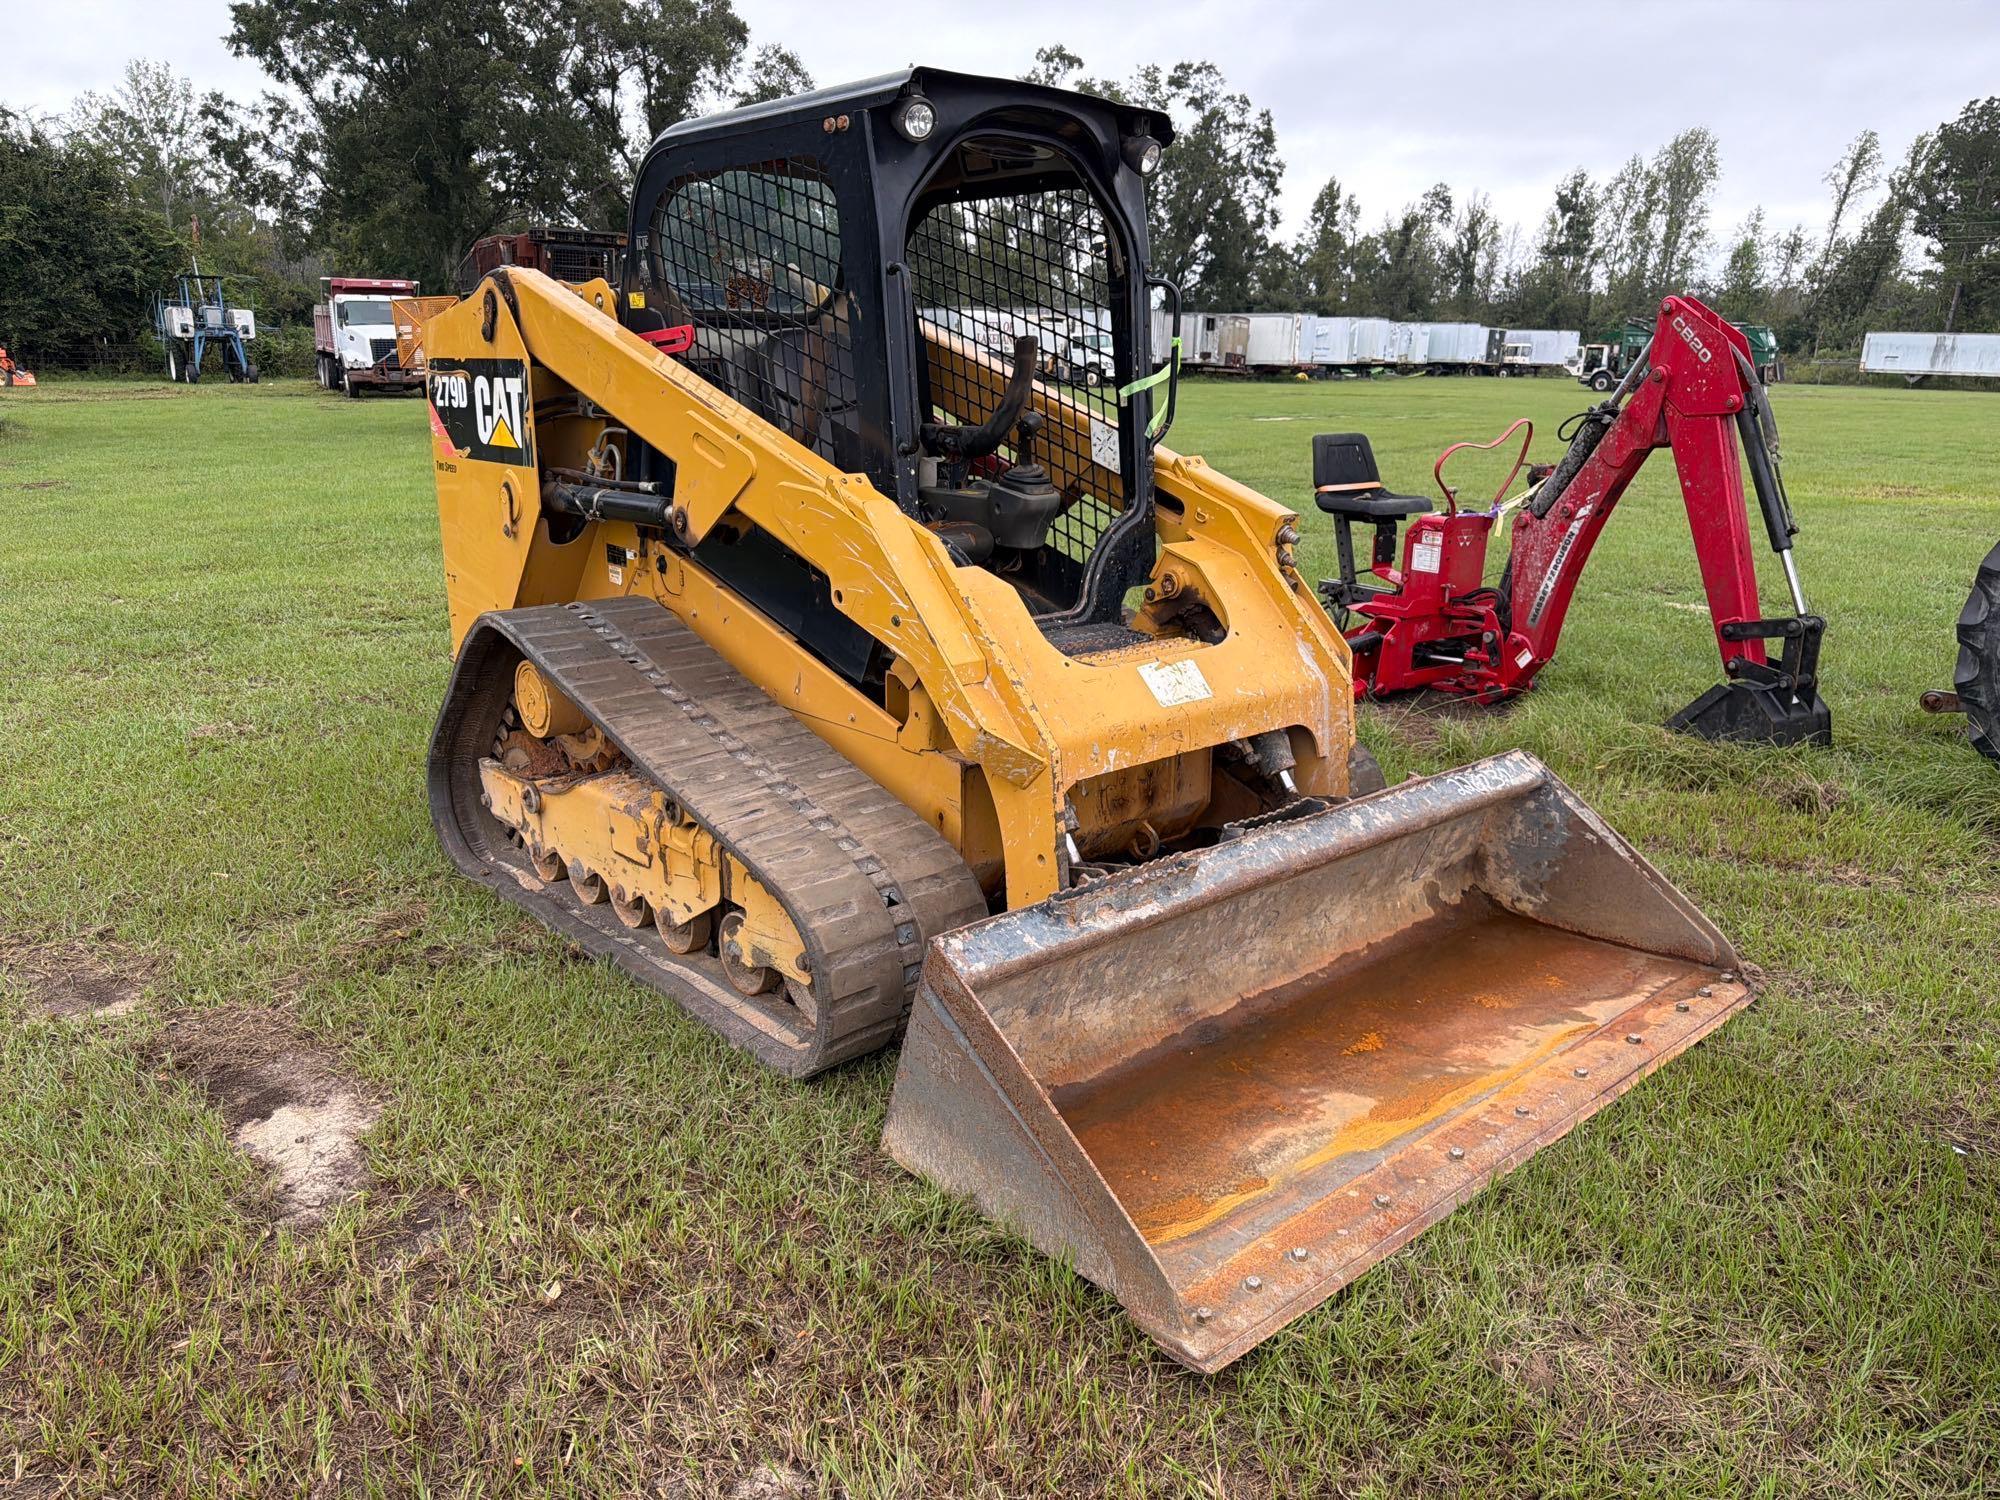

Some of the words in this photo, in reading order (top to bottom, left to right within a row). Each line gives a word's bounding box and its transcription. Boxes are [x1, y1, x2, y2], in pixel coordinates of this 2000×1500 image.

[1672, 316, 1712, 363] CB20
[434, 375, 468, 409] 279D
[474, 375, 523, 449] CAT
[1530, 583, 1550, 623] MASSEY
[1547, 530, 1575, 583] FERGUSON
